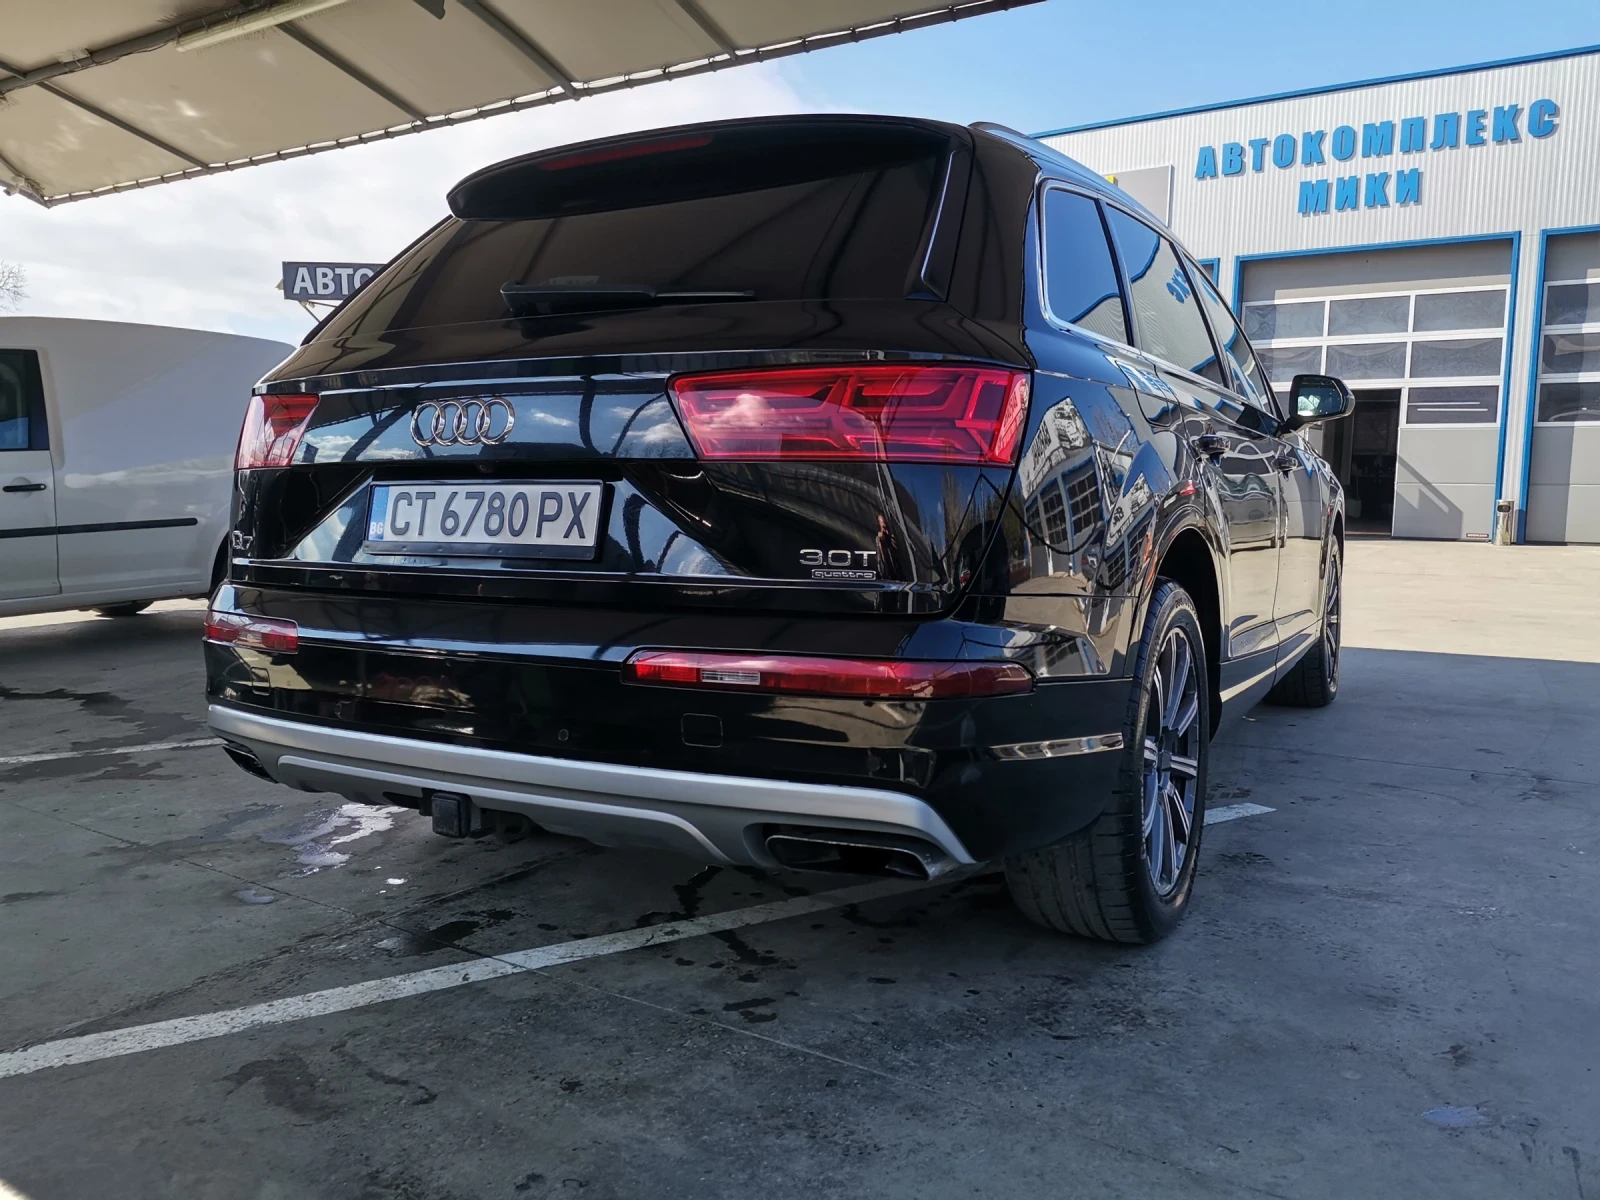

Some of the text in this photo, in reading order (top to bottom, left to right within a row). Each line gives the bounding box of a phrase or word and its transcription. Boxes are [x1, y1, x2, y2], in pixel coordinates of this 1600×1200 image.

[1194, 98, 1559, 180] АВТОКОМПЛЕКС
[1297, 167, 1421, 215] МИКИ
[369, 521, 384, 535] BG
[231, 530, 254, 551] Q7
[813, 570, 875, 579] quattro
